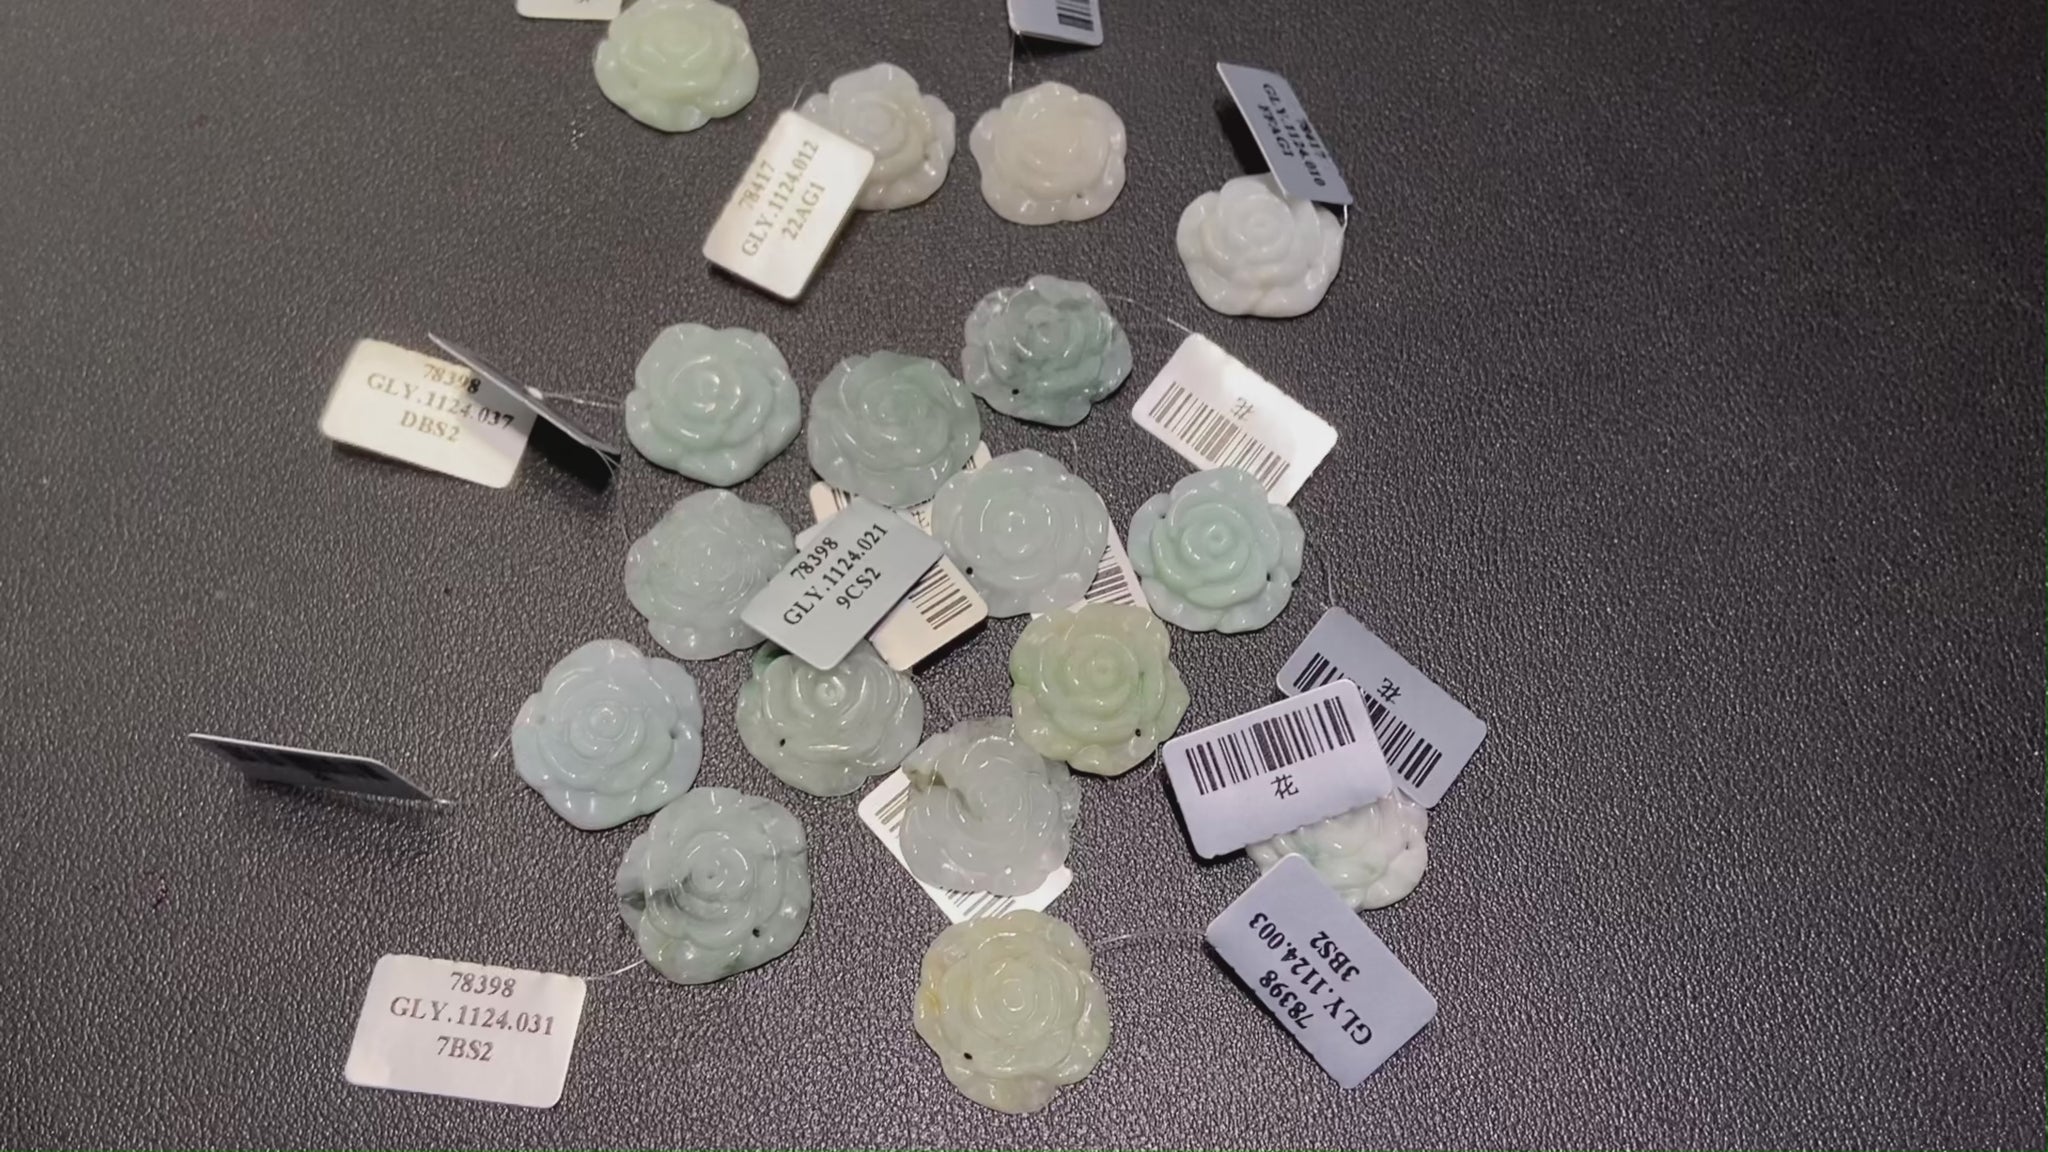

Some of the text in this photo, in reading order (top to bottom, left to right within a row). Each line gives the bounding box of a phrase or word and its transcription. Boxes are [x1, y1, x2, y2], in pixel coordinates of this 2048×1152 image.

[738, 160, 776, 210] 78417
[741, 140, 819, 257] GLY.1124.012
[781, 181, 826, 241] 22AG1
[366, 371, 515, 431] GLY.1124.037
[1230, 396, 1255, 422] 花
[400, 409, 461, 443] DBS2
[783, 523, 889, 626] GLY.1124.021
[790, 536, 839, 581] 78398
[836, 566, 882, 610] 9CS2
[1376, 677, 1402, 704] 花
[1270, 773, 1300, 800] 花
[1249, 912, 1373, 1046] GLY.1124.003
[1310, 931, 1361, 983] 3BS2
[449, 971, 517, 999] 78398
[1259, 970, 1314, 1030] 78398
[389, 996, 555, 1036] GLY.1124.031
[436, 1035, 494, 1063] 7BS2
